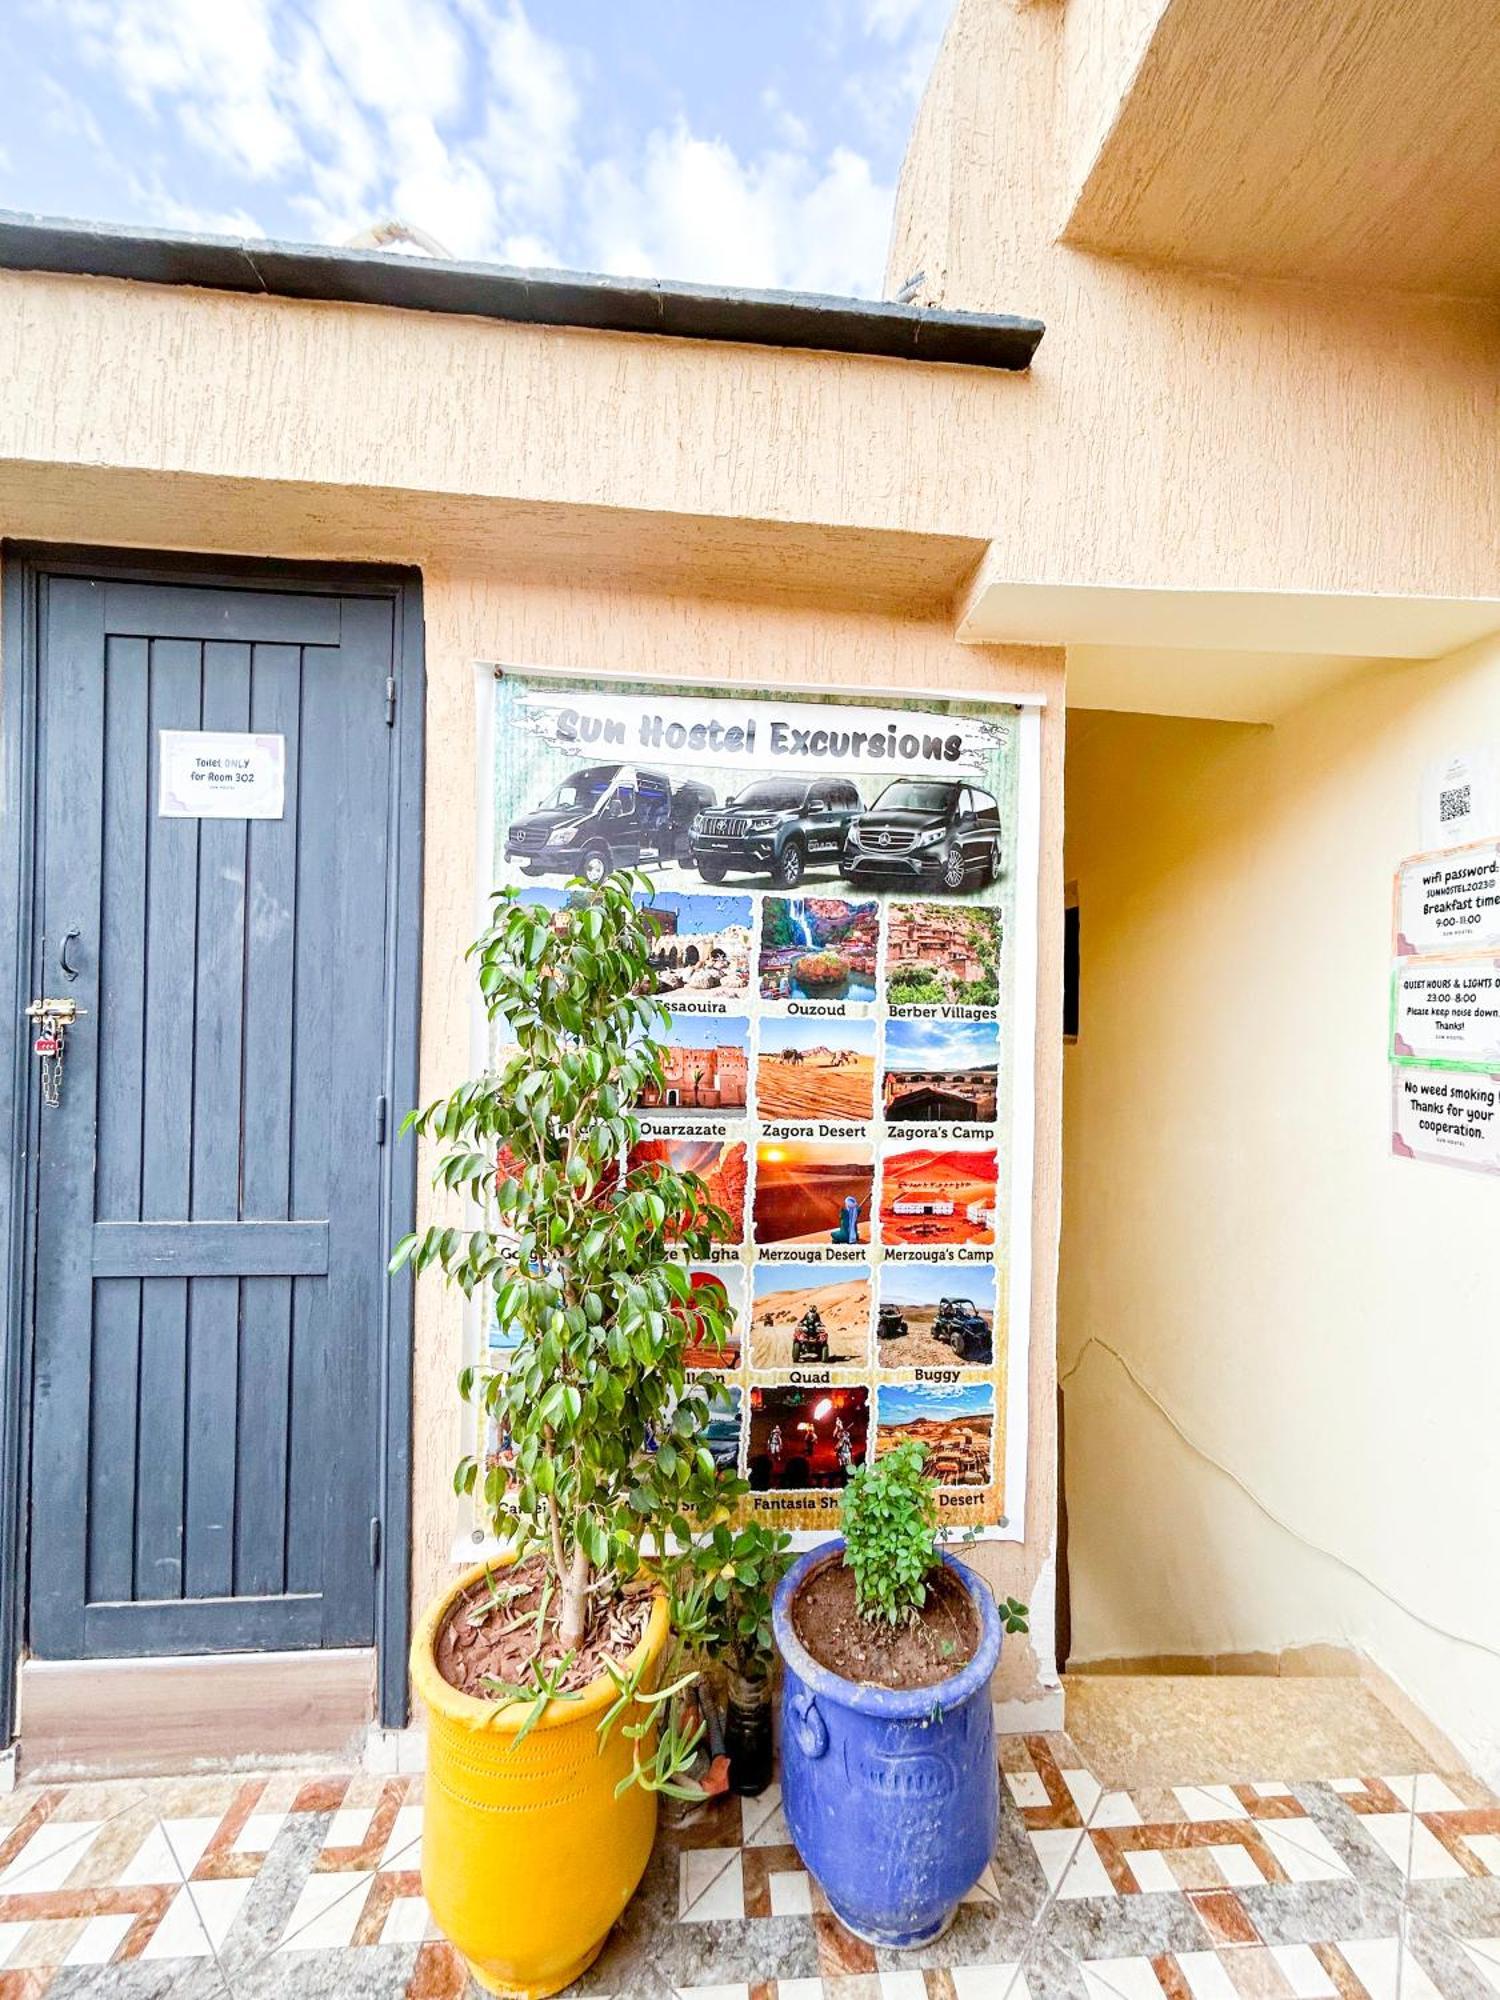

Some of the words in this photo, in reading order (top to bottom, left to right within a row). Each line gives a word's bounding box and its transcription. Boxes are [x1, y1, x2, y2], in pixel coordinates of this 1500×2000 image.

[557, 709, 626, 745] Sun
[638, 714, 757, 755] Hostel
[770, 722, 962, 762] Excursions
[224, 758, 250, 769] ONLY
[190, 771, 206, 781] for
[208, 771, 232, 782] Room
[235, 772, 255, 783] 302
[1424, 897, 1473, 915] Breakfast
[1426, 979, 1452, 989] HOURS
[1463, 978, 1492, 989] LIGHTS
[787, 1003, 846, 1016] Ouzoud
[889, 1006, 937, 1018] Berber
[940, 1007, 997, 1020] Villages
[1406, 1006, 1429, 1016] Please
[1431, 1007, 1450, 1019] keep
[1404, 1081, 1418, 1094] No
[1420, 1084, 1447, 1097] weed
[1450, 1088, 1494, 1107] smoking
[1410, 1099, 1444, 1114] Thanks
[1446, 1103, 1464, 1116] for
[1466, 1109, 1494, 1123] your
[640, 1123, 727, 1136] Ouarzazate
[762, 1124, 814, 1138] Zagora
[818, 1124, 866, 1137] Desert
[887, 1126, 949, 1140] Zagora's
[951, 1126, 994, 1140] Camp
[759, 1249, 822, 1261] Merzouga
[825, 1249, 866, 1260] Desert
[885, 1249, 954, 1261] Merzouga's
[958, 1250, 994, 1263] Camp
[789, 1371, 830, 1383] Quad
[915, 1369, 961, 1382] Buggy
[939, 1492, 985, 1506] Desert
